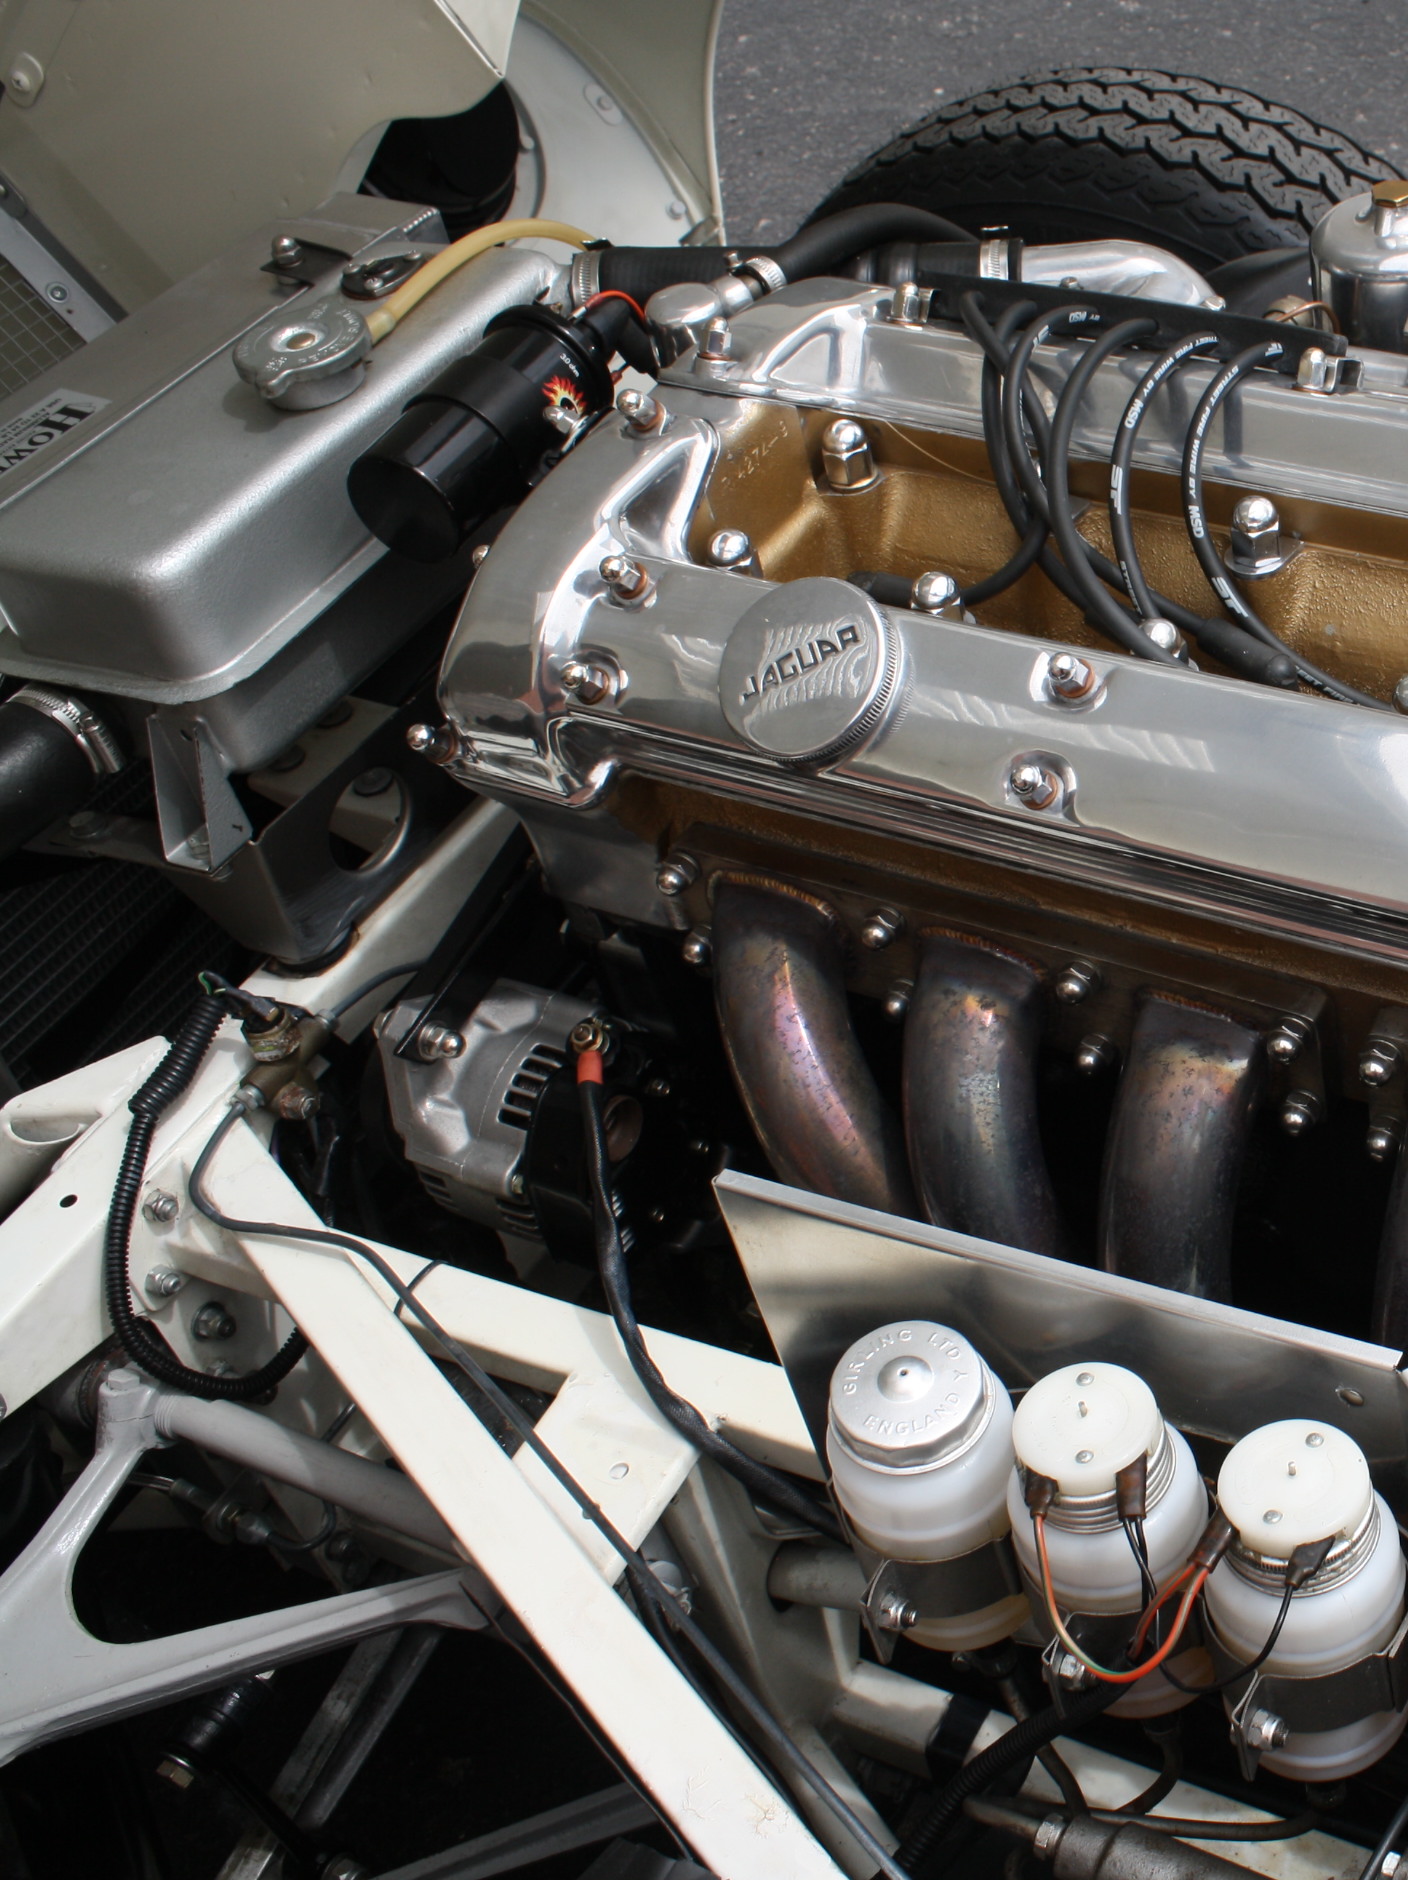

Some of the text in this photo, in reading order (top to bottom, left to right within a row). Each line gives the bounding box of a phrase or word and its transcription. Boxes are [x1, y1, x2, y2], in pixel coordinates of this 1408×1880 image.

[1143, 379, 1155, 397] BY
[1154, 357, 1175, 380] WIRE
[1124, 399, 1144, 428] MSD
[1188, 365, 1239, 539] STREET FIRE WIRE BY MSD
[1110, 464, 1123, 515] SF
[1211, 577, 1249, 617] SF
[739, 625, 860, 706] JAGUAR
[842, 1329, 961, 1396] GIRLING LTD
[863, 1392, 960, 1436] ENGLAND
